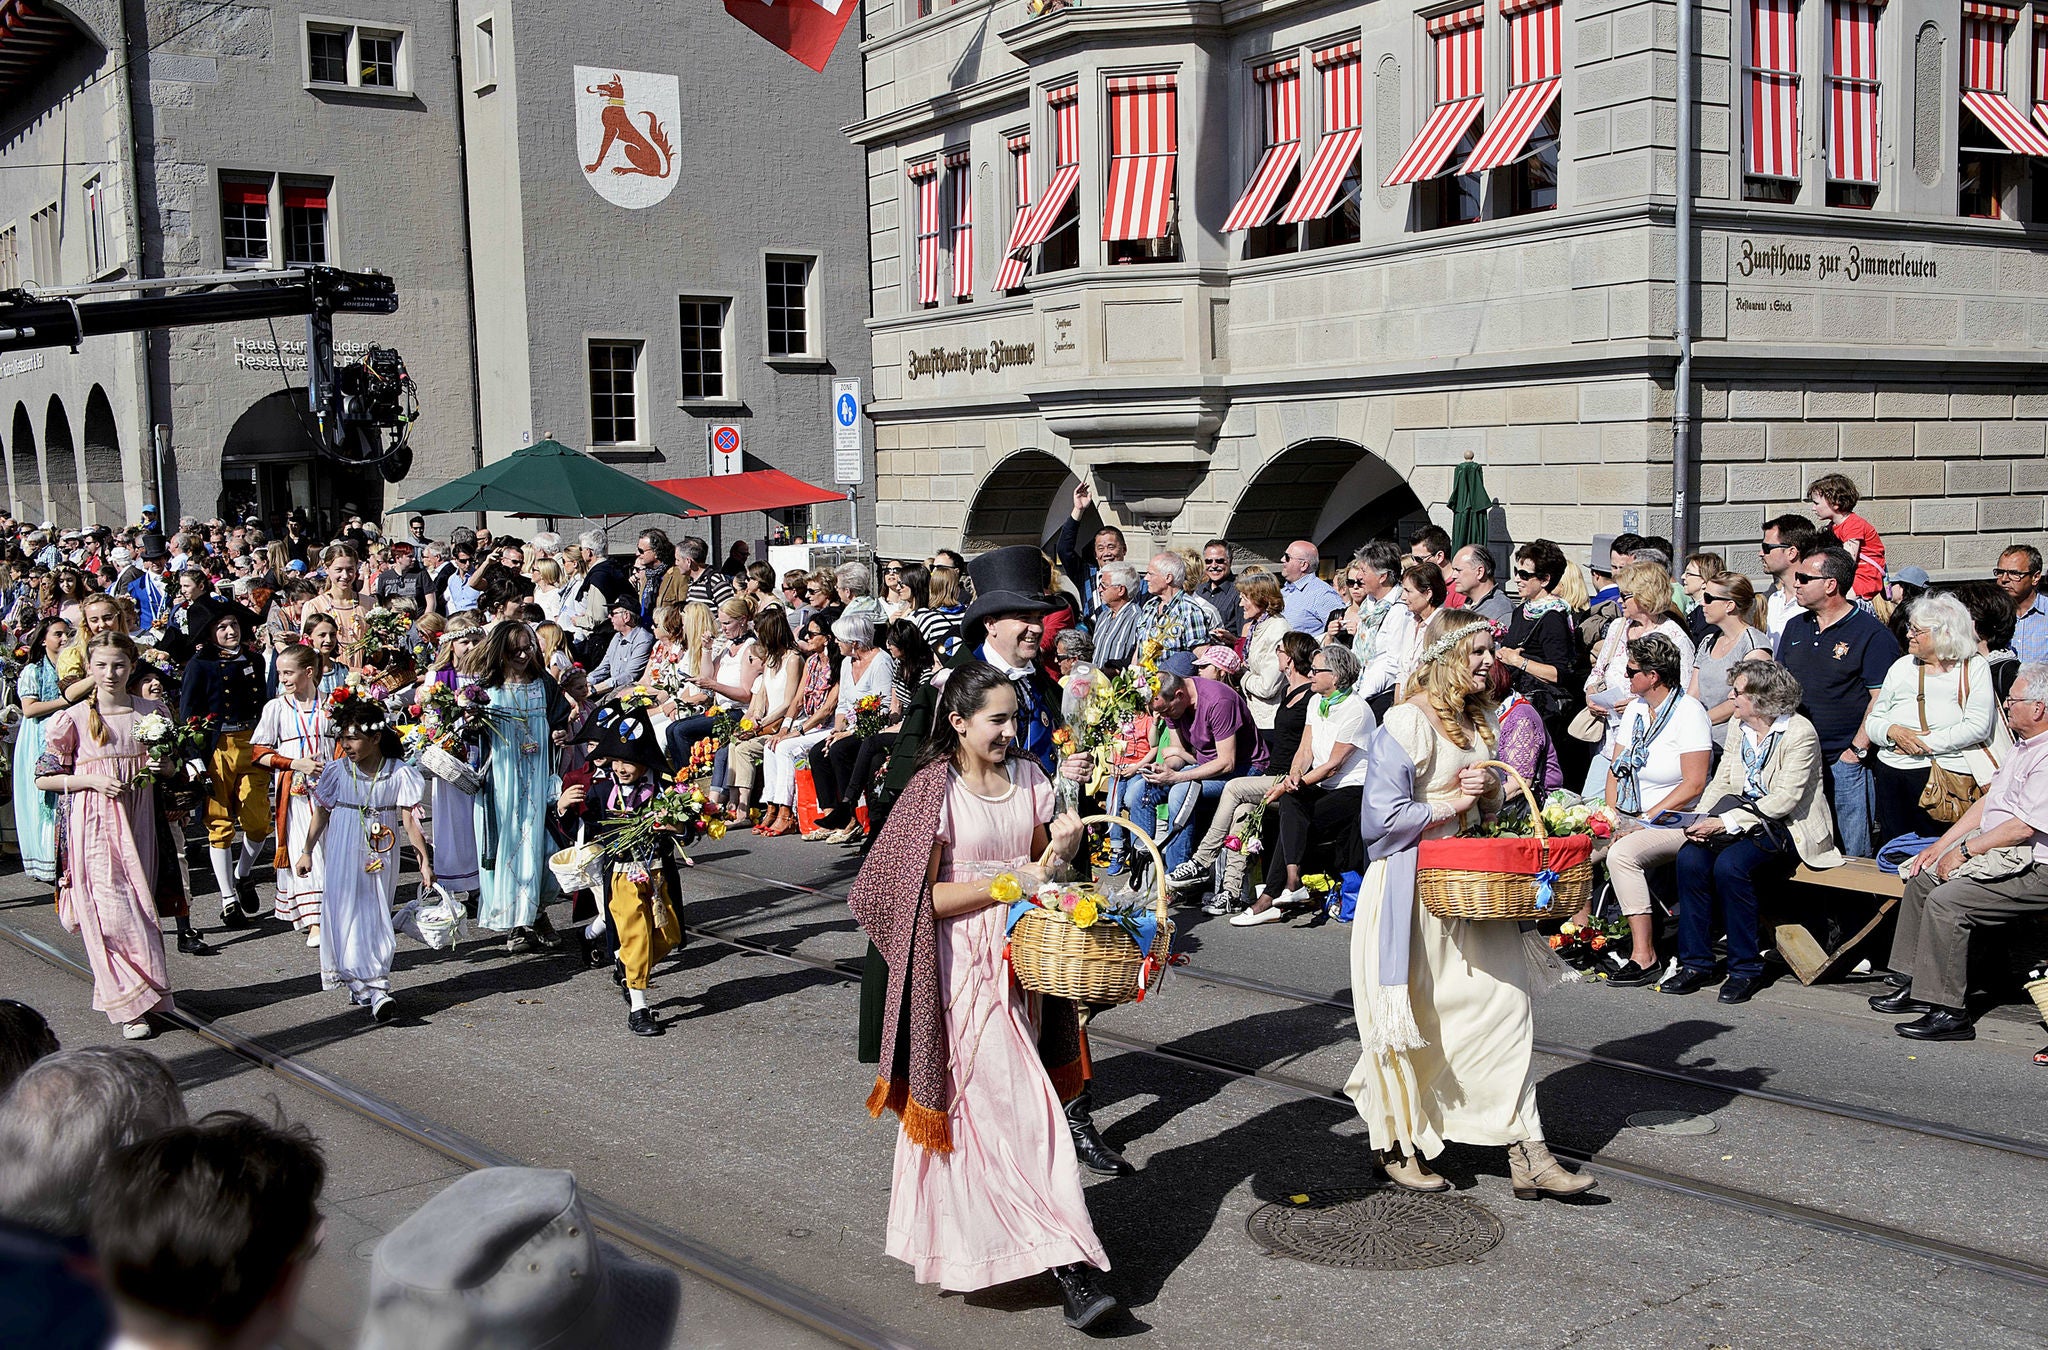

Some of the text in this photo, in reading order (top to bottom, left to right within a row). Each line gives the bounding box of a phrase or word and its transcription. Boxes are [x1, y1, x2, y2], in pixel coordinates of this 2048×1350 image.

[1736, 239, 1937, 281] Zunfthaus zur Zimmerleuten
[233, 337, 276, 350] Haus
[332, 339, 370, 352] üden
[234, 353, 308, 367] Restaura
[908, 346, 968, 380] Zunfthaus
[969, 347, 988, 376] zur
[840, 383, 853, 391] ZONE
